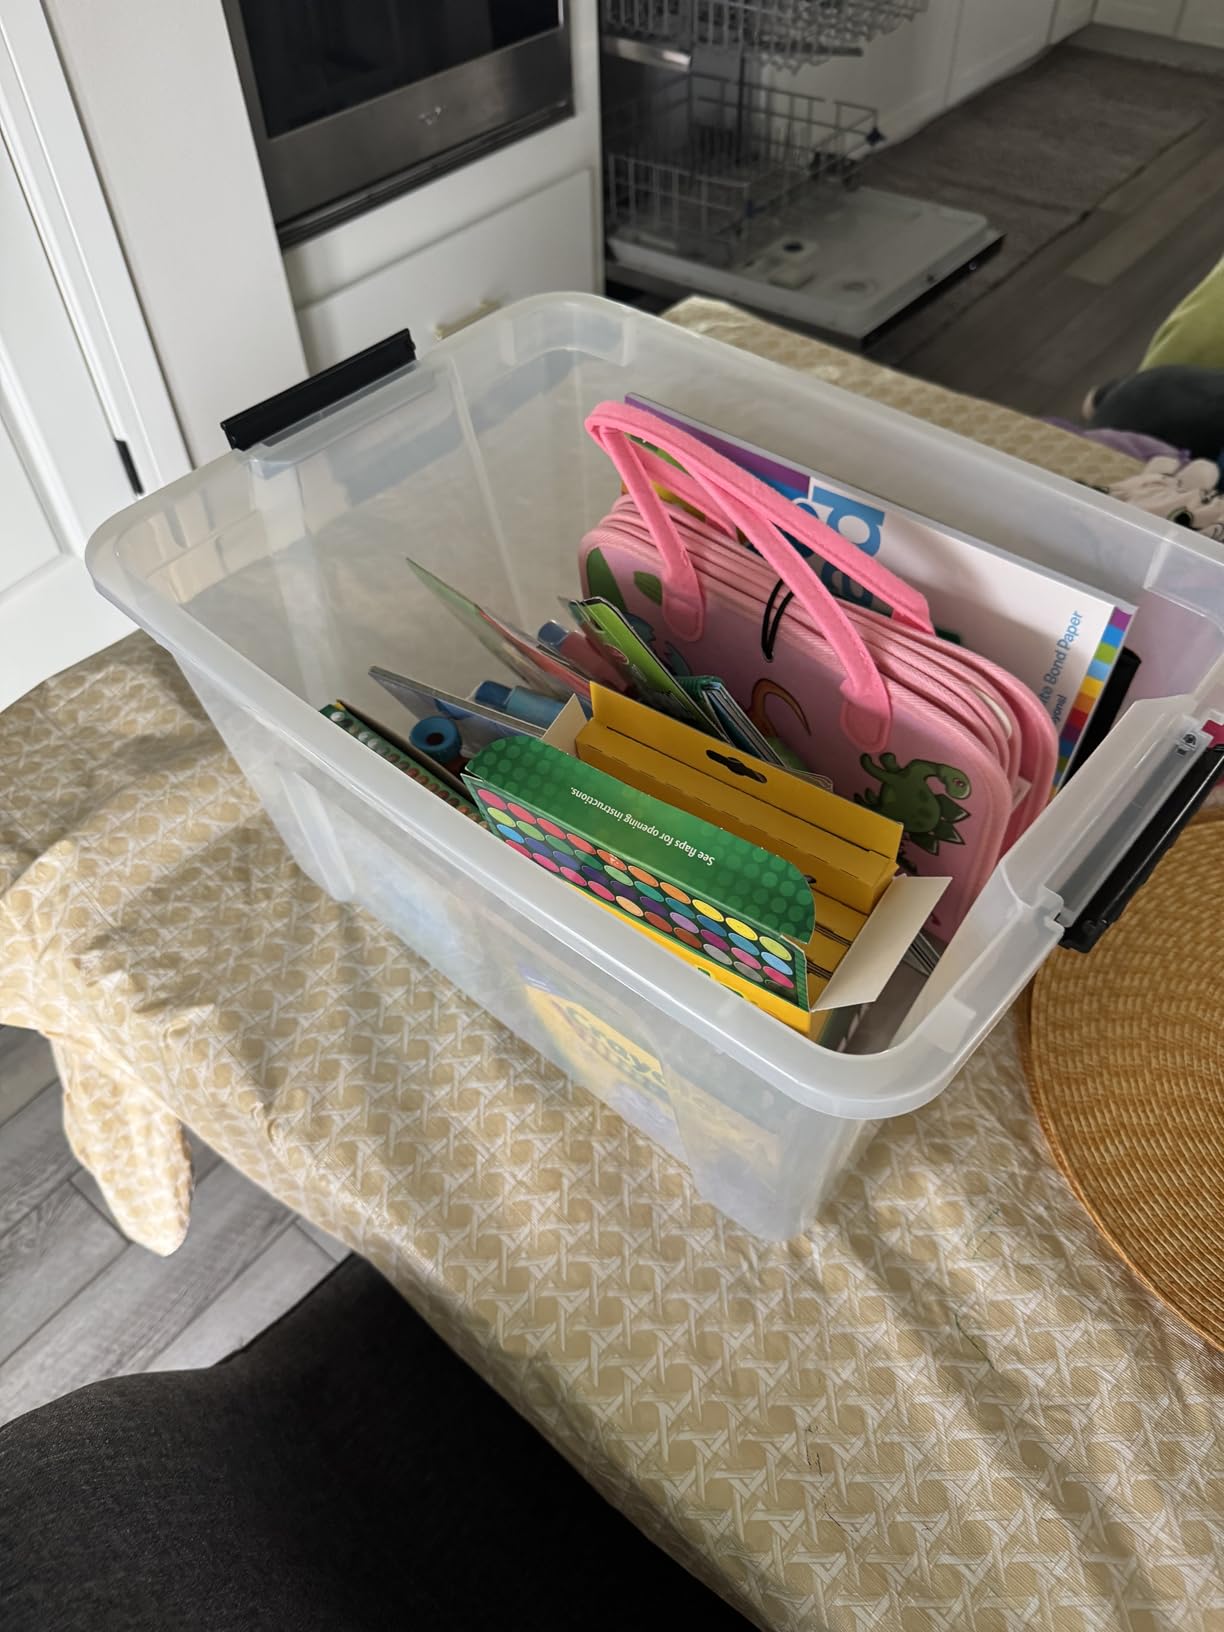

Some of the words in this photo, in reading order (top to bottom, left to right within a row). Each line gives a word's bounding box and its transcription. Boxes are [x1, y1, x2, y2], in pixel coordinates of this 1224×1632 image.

[1043, 650, 1067, 685] Bond
[1056, 610, 1084, 650] Paper
[570, 786, 624, 822] instructions.
[623, 813, 660, 837] opening
[658, 832, 676, 846] for
[674, 839, 698, 858] flaps
[697, 850, 716, 866] See
